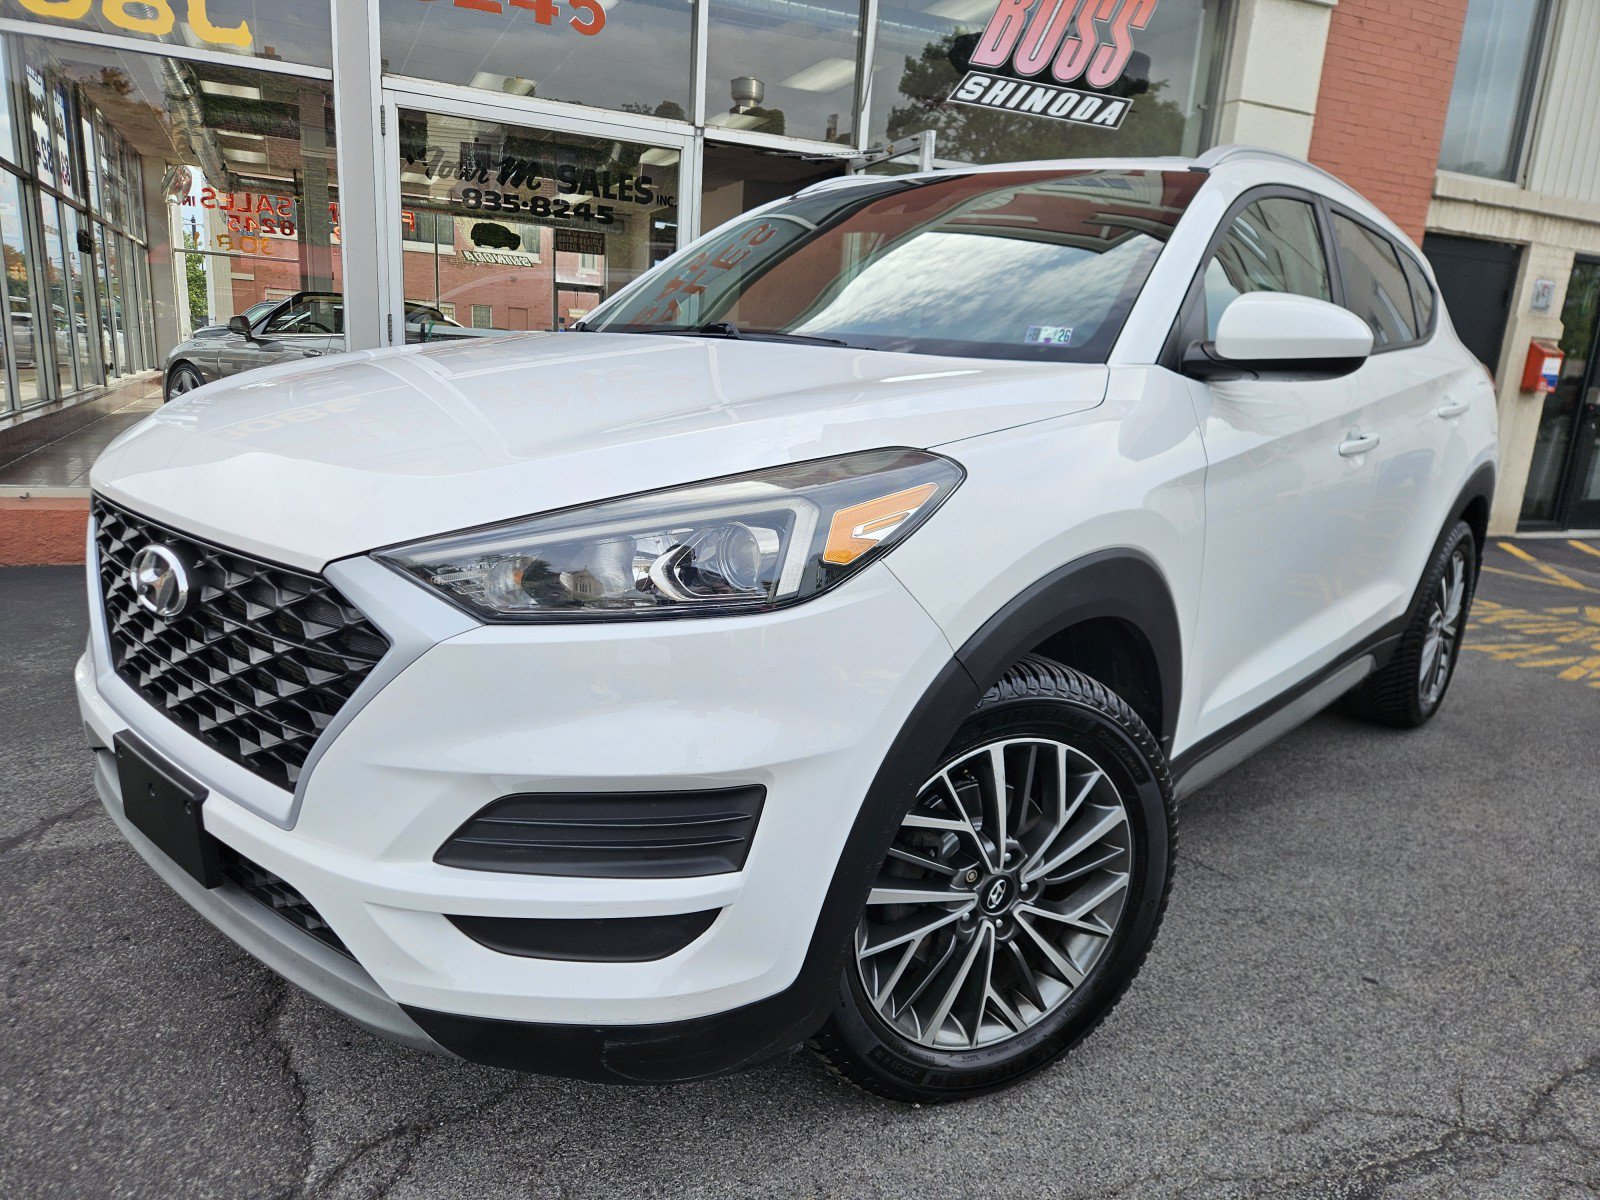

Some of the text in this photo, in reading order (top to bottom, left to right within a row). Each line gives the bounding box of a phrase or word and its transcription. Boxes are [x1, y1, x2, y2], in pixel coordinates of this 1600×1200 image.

[956, 75, 1126, 127] SHINODA
[557, 164, 654, 205] SALES
[1057, 329, 1071, 343] 26
